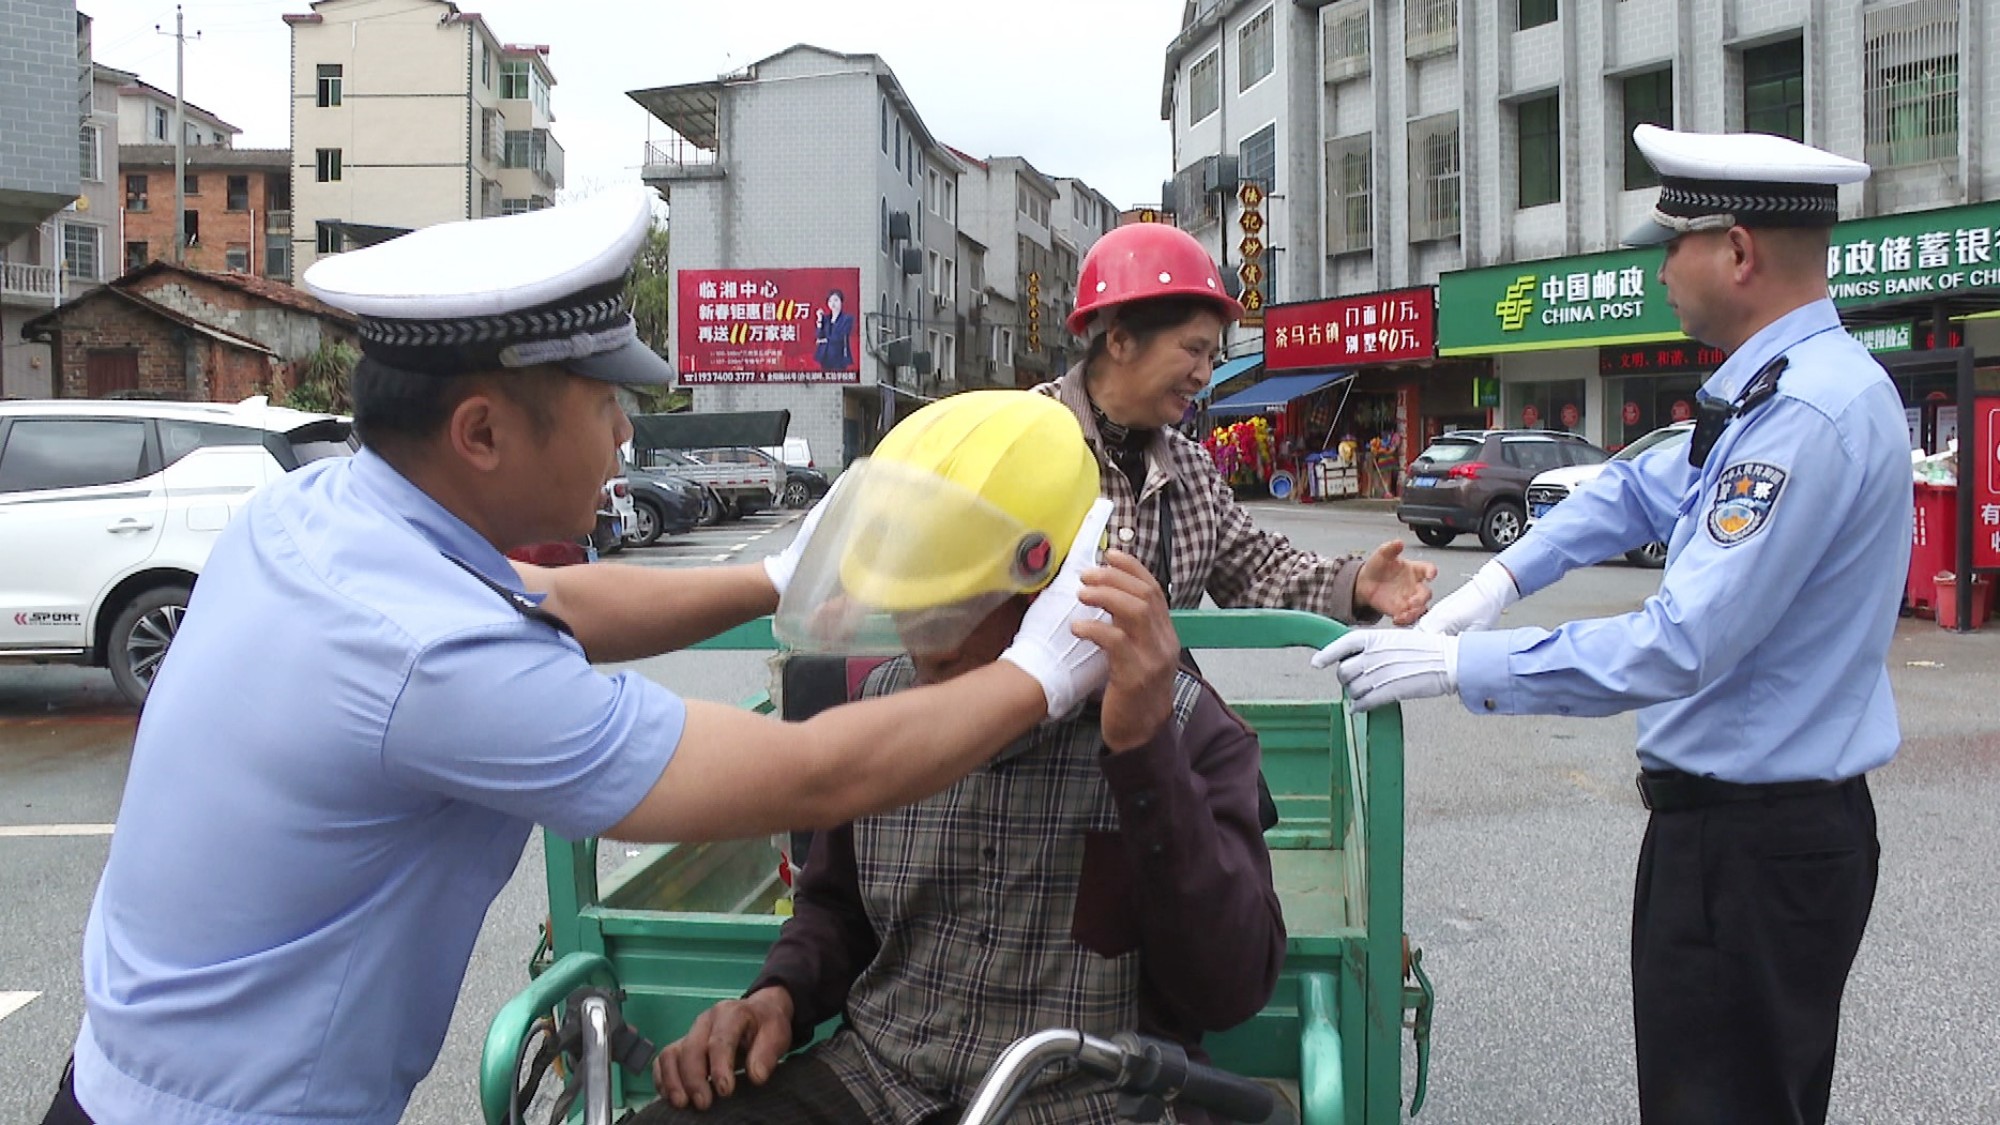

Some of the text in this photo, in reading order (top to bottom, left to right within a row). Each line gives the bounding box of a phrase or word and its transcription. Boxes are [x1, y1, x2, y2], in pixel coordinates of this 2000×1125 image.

[1827, 227, 2000, 279] 政储蓄银
[699, 280, 778, 299] 临湘中心
[1541, 265, 1644, 305] 中国邮政
[1885, 275, 1934, 294] BANK
[1938, 272, 1965, 289] OF
[1541, 301, 1644, 325] CHINA POST
[1275, 321, 1340, 349] 茶马古镇
